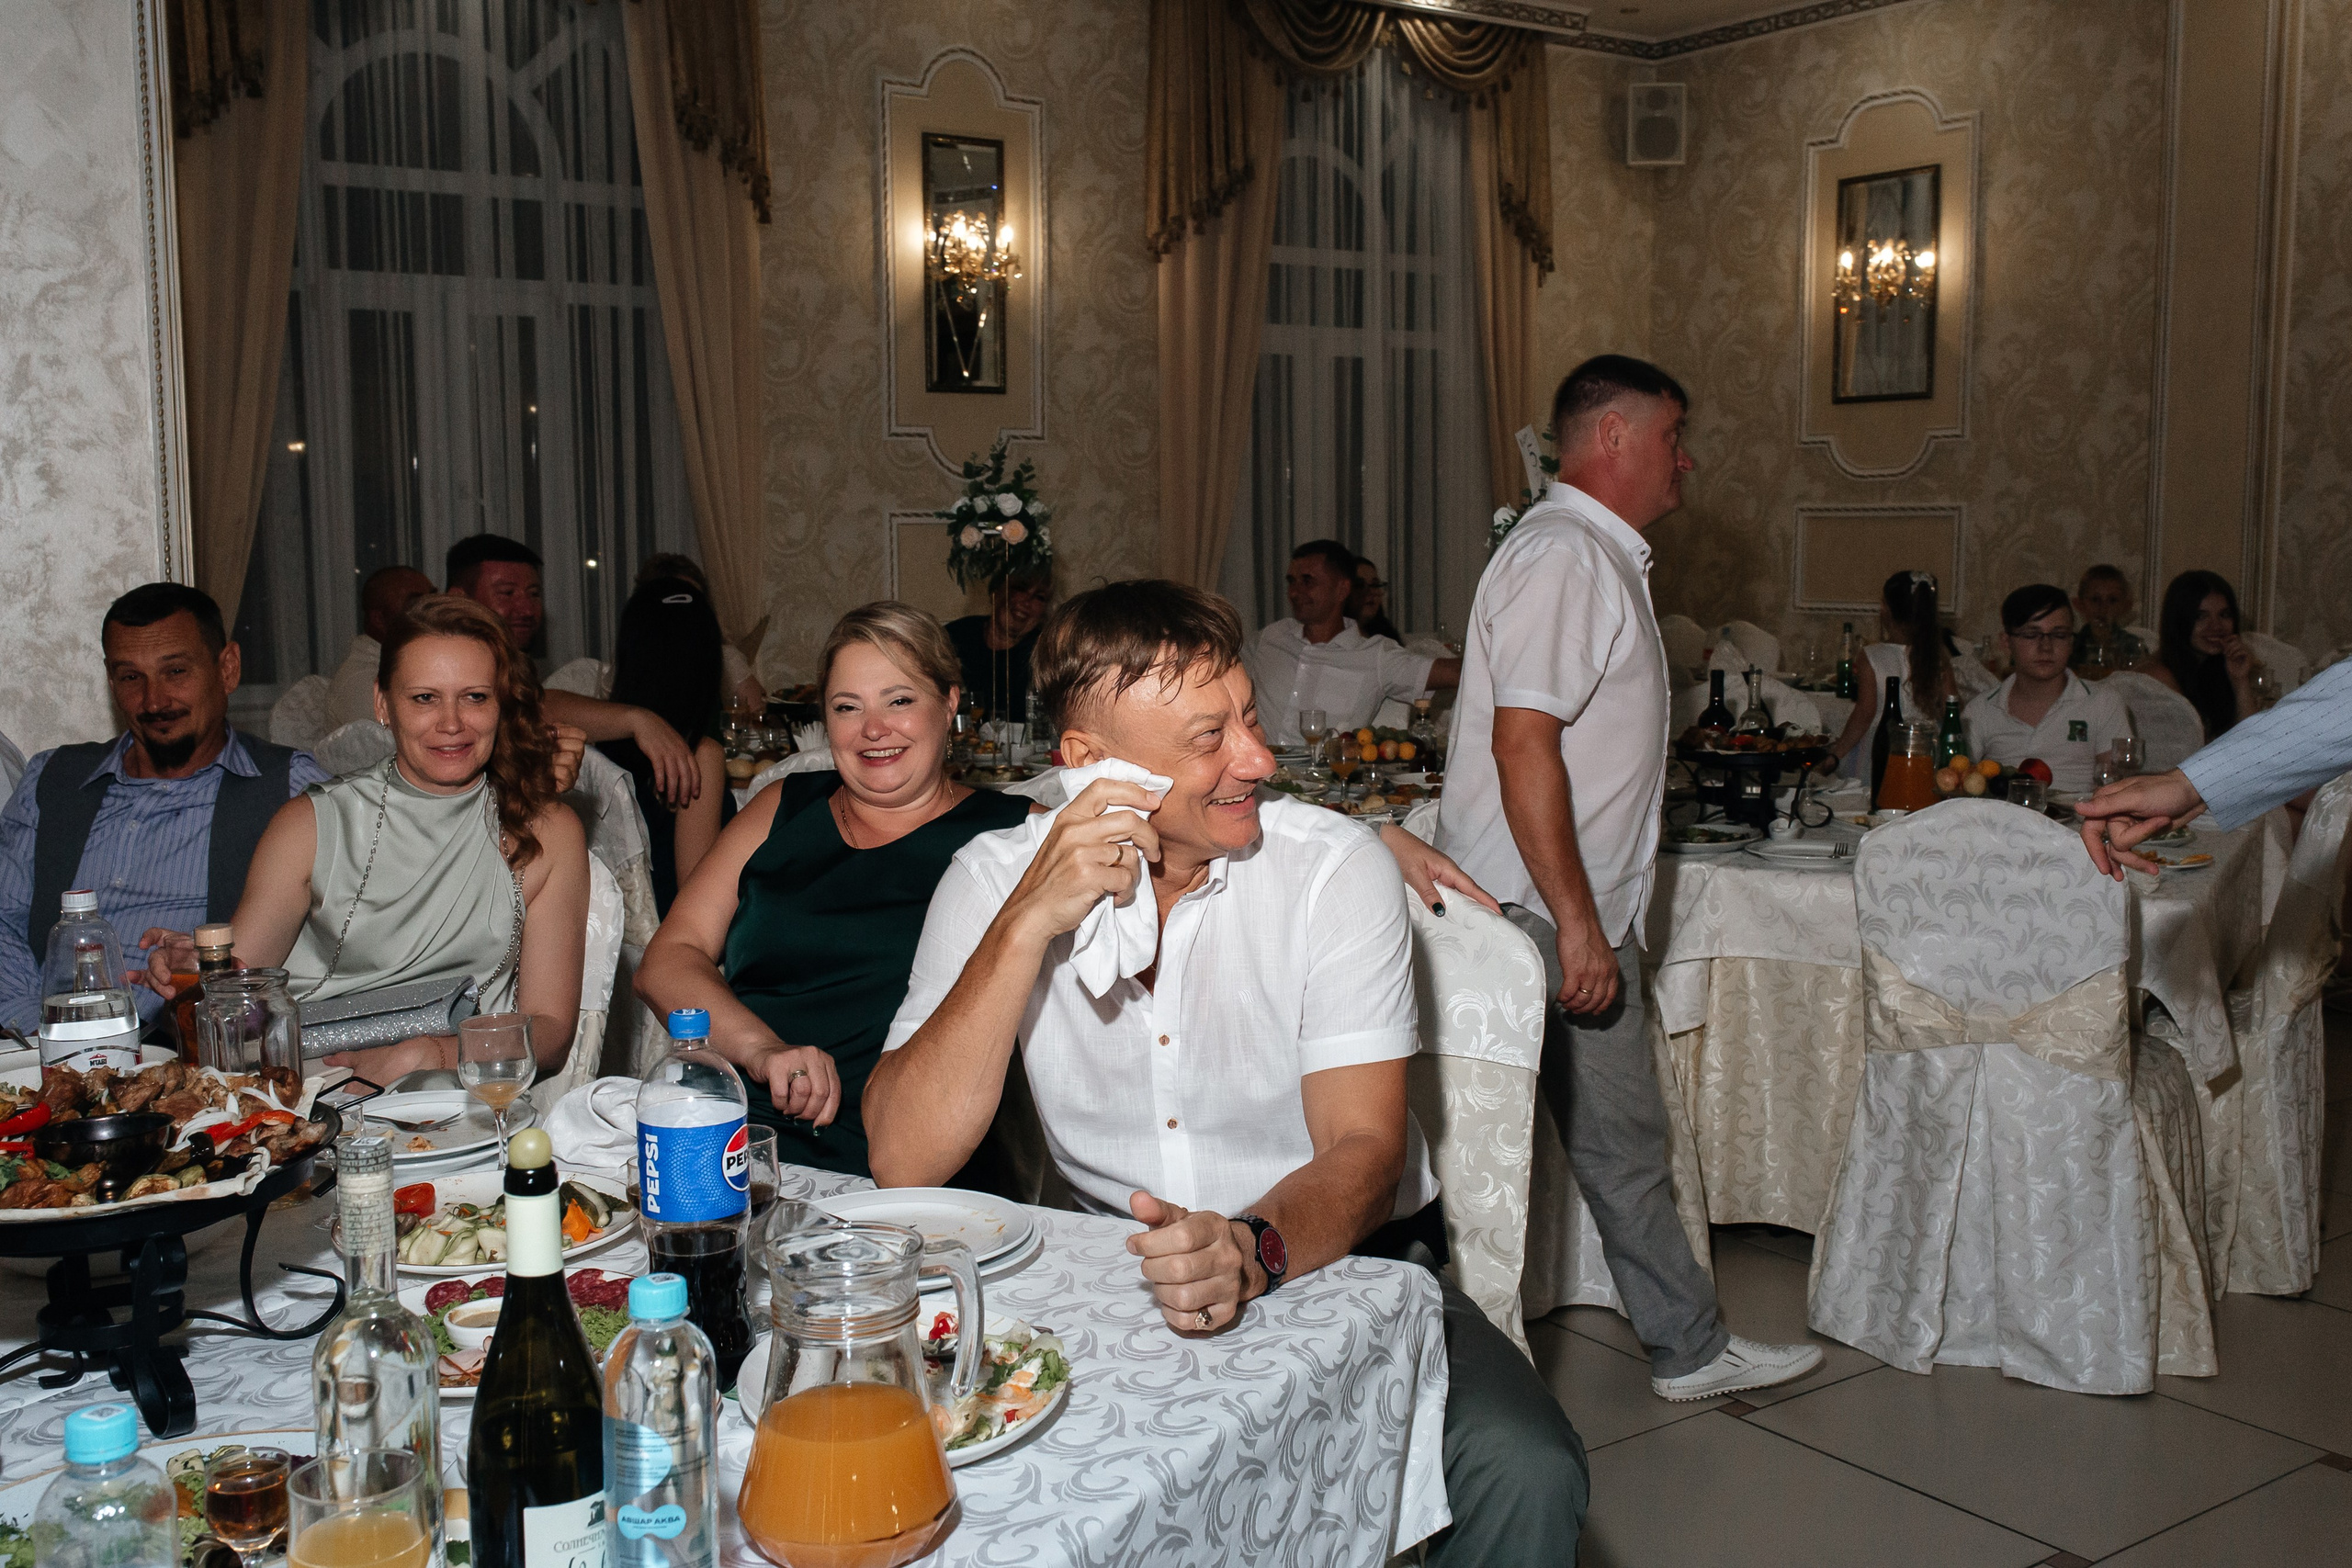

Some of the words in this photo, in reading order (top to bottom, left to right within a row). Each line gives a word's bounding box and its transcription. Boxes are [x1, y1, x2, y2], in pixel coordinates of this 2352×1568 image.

[645, 1133, 661, 1213] PEPSI
[621, 1516, 652, 1525] АВШАР
[654, 1515, 681, 1524] АКВА
